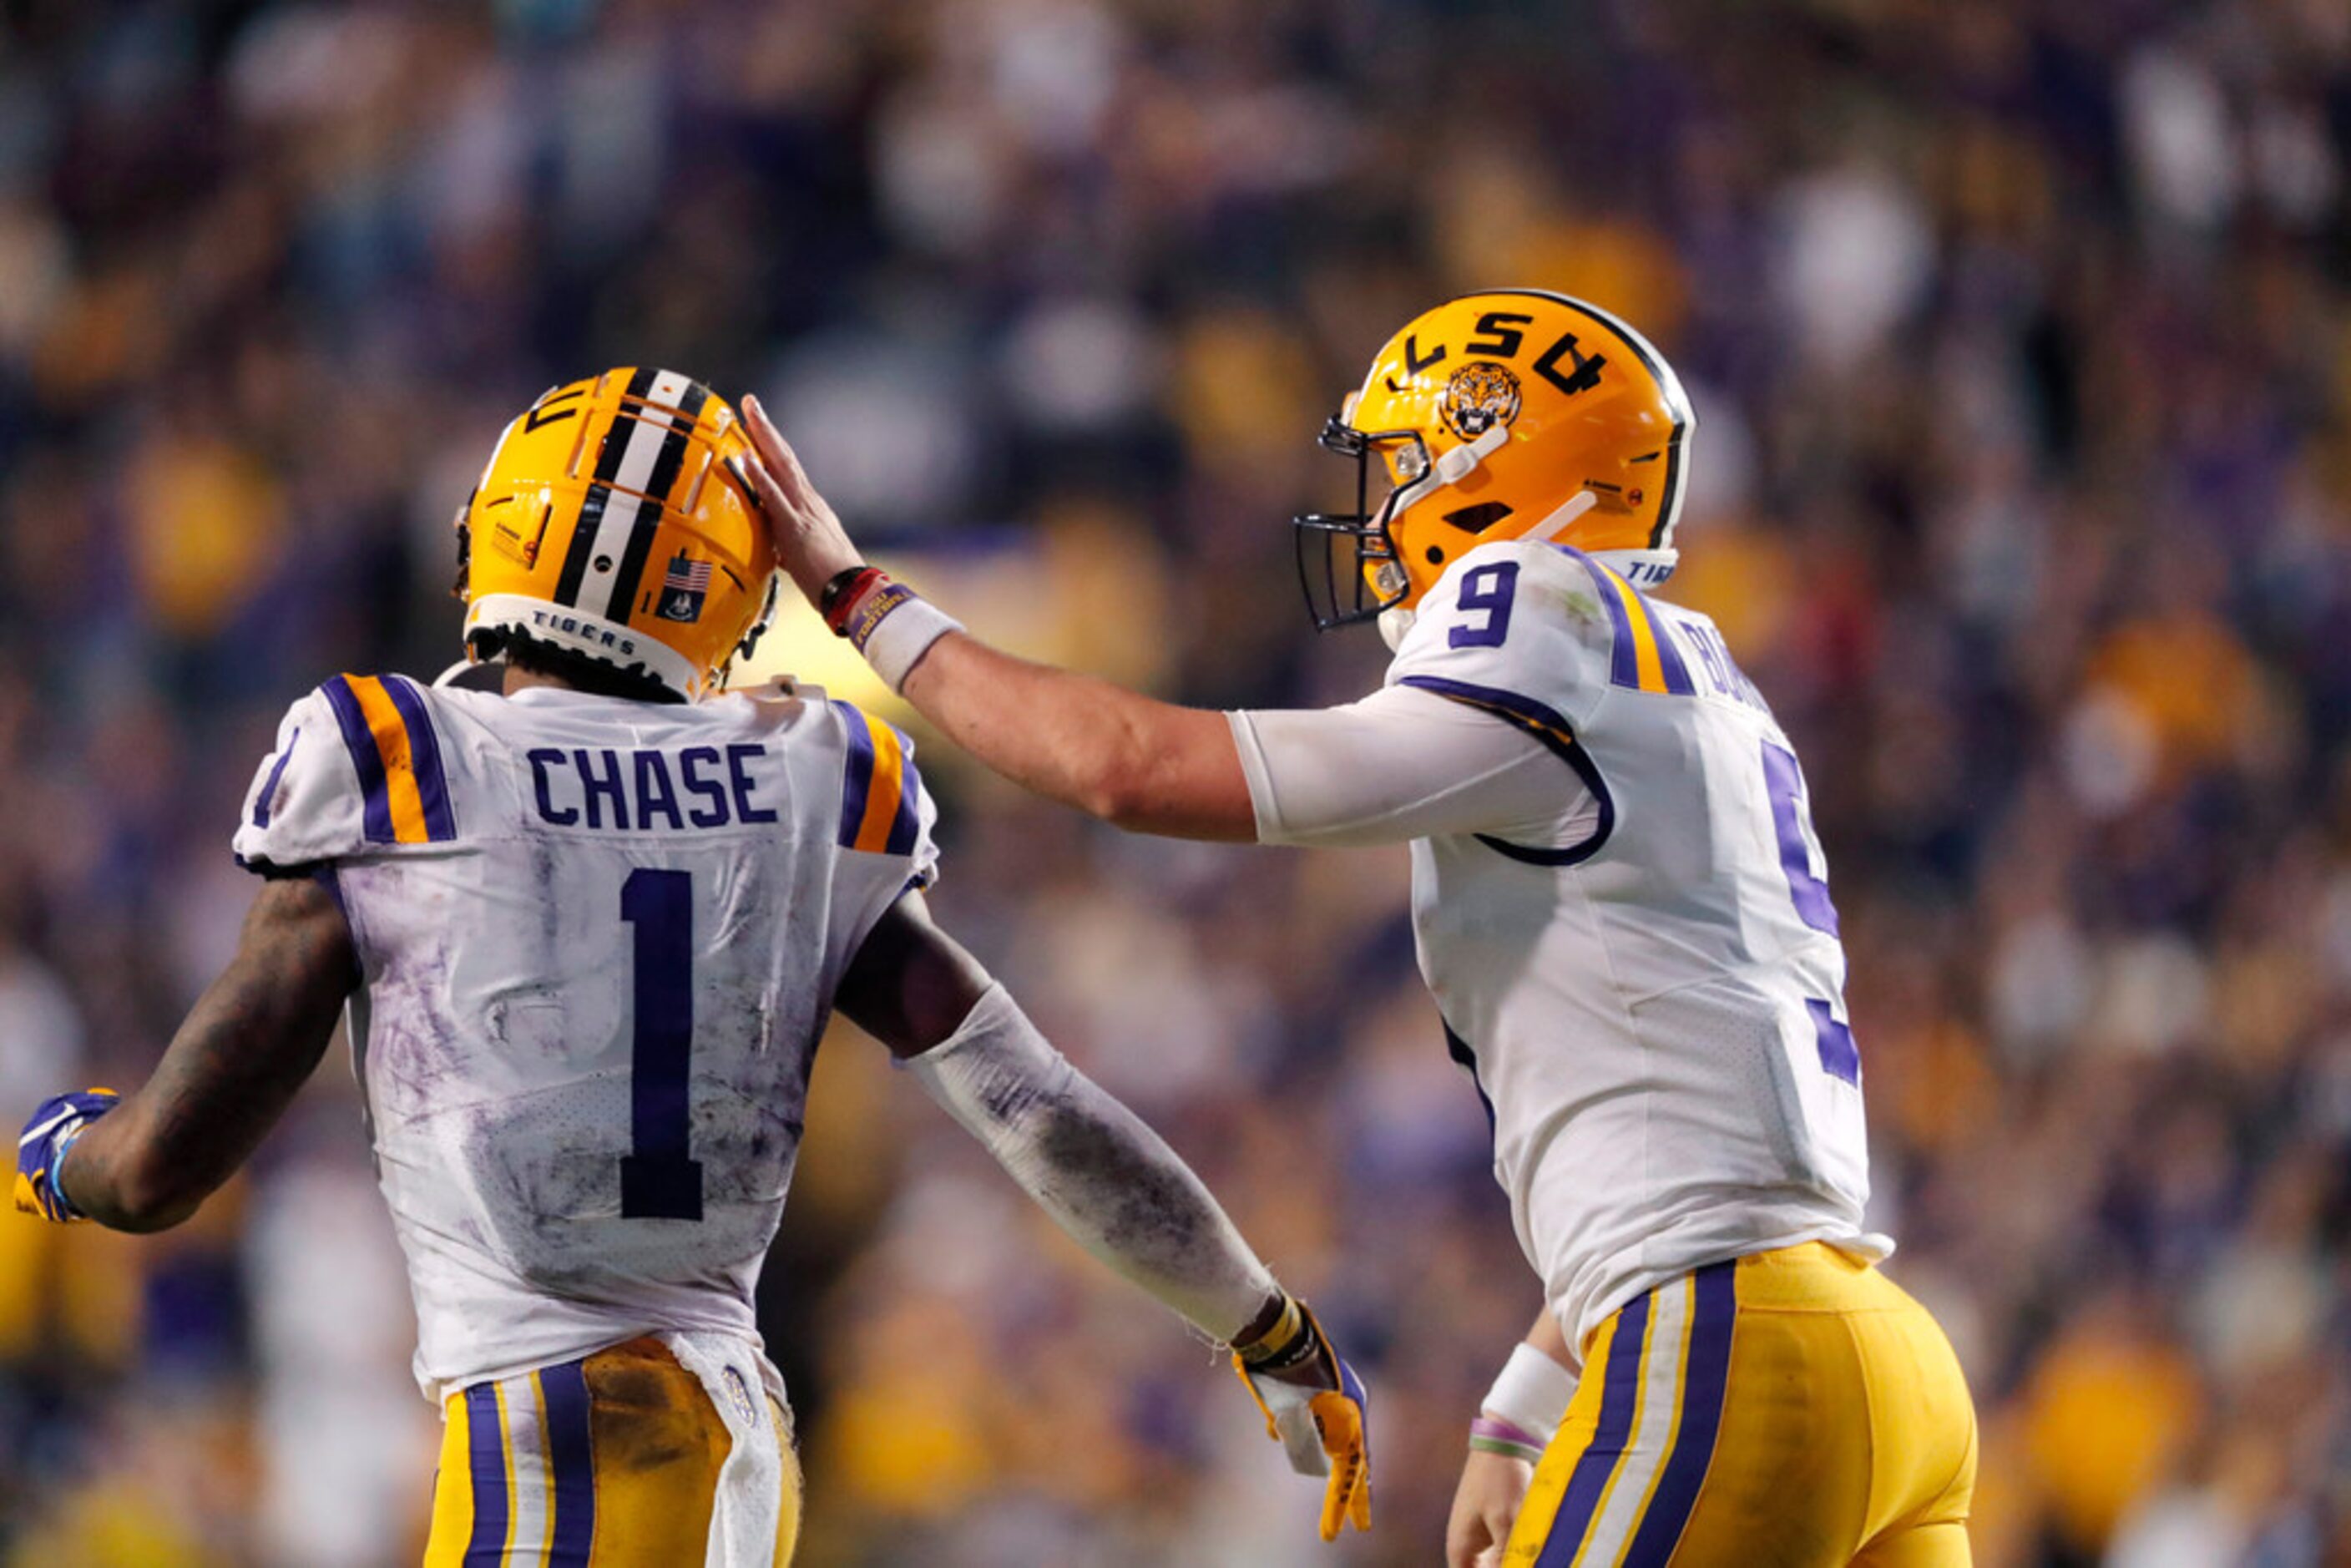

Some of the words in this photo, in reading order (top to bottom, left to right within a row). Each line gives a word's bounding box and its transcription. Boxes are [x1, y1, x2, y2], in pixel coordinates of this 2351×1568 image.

[533, 609, 635, 655] TIGERS
[1448, 560, 1520, 650] 9
[527, 744, 778, 830] CHASE
[620, 868, 704, 1221] 1
